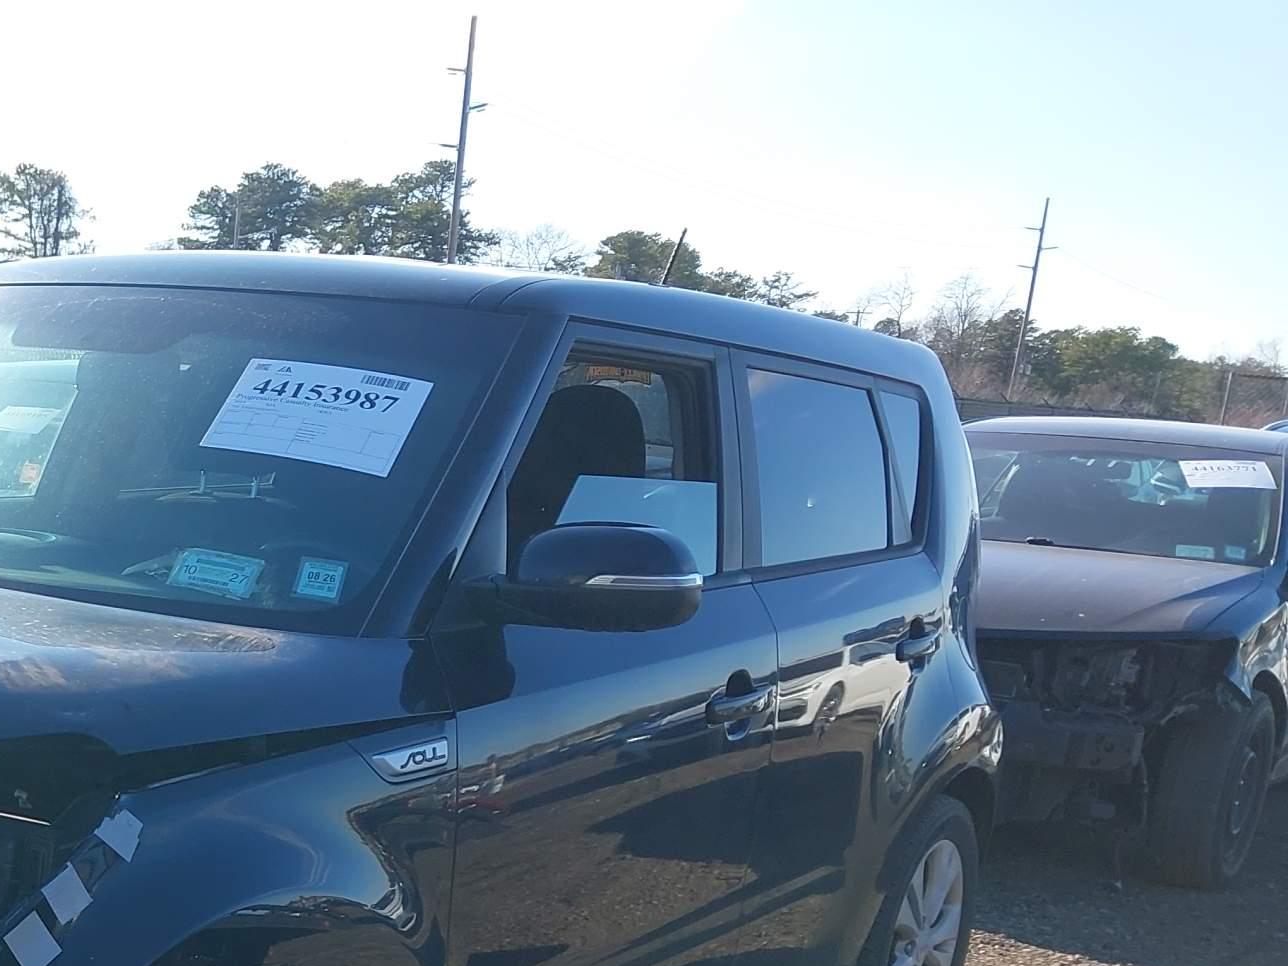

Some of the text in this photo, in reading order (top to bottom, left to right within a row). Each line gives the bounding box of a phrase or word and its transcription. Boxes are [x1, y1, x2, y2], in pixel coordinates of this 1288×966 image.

[253, 378, 400, 413] 44153987
[279, 397, 312, 407] Casualty
[312, 401, 350, 412] Insurance
[183, 564, 199, 575] 10
[228, 573, 249, 585] 27
[307, 571, 337, 583] 08 26
